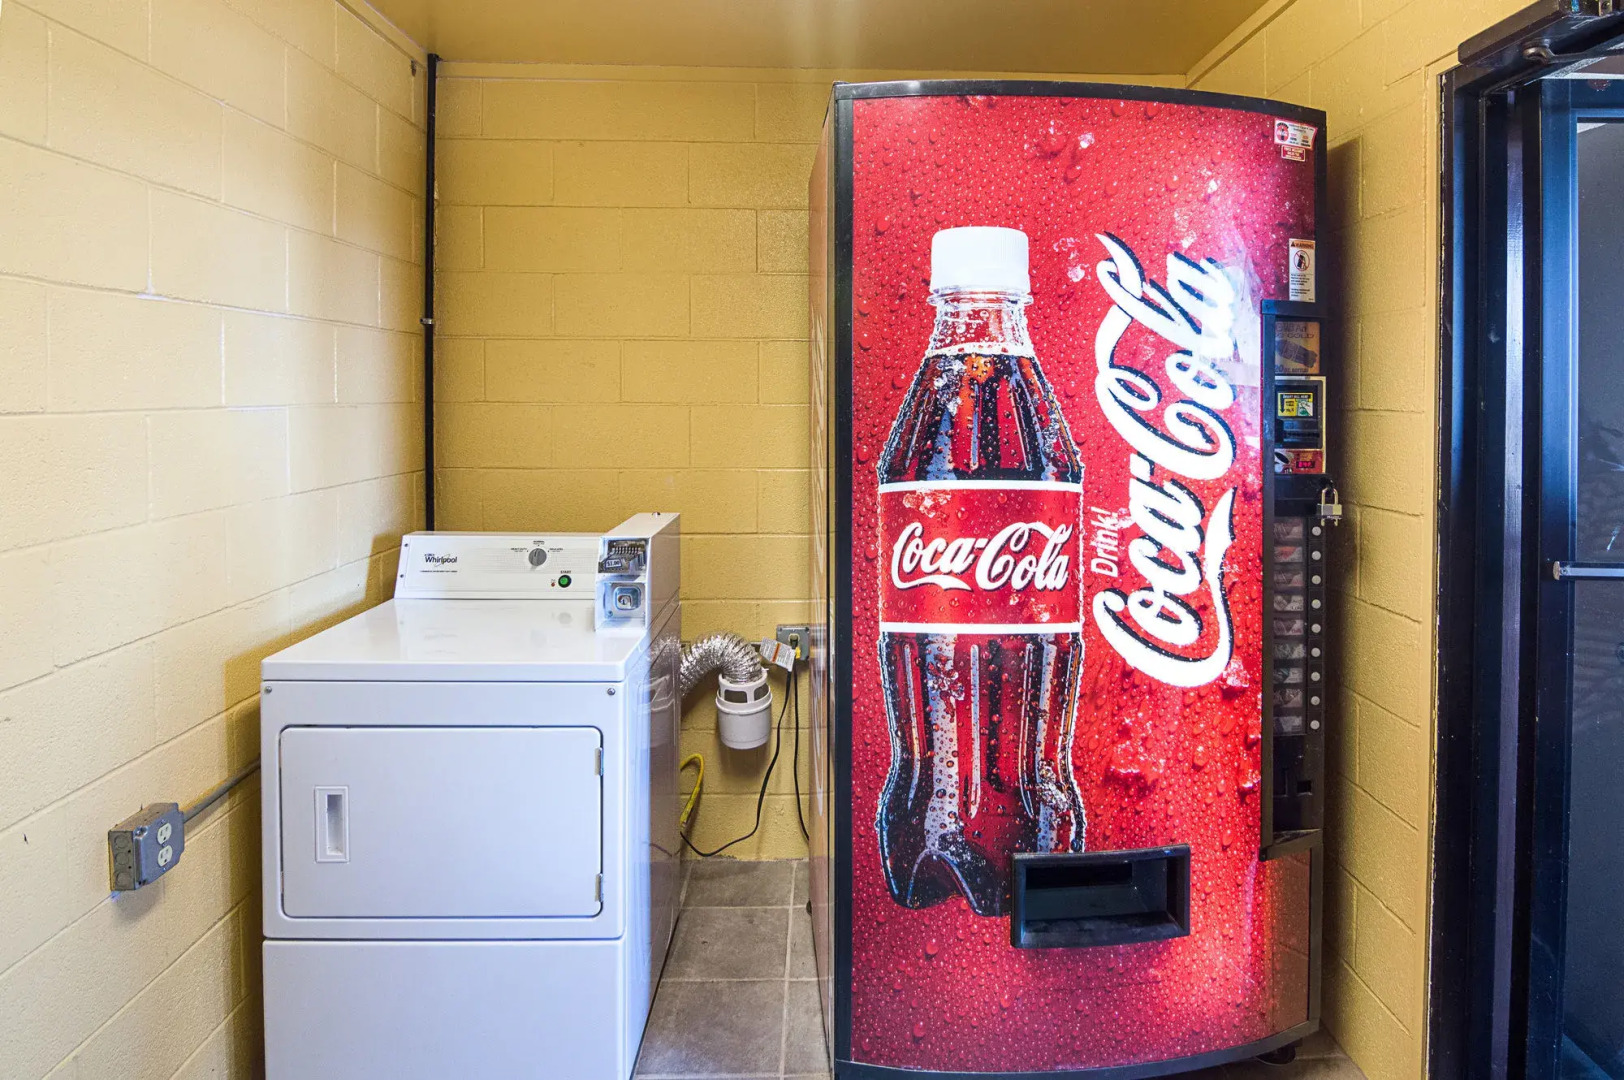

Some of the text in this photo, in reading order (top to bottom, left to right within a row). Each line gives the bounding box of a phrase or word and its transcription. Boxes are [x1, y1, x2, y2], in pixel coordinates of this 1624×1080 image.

[1092, 231, 1237, 688] Coca-Cola
[425, 556, 458, 565] Whirlpool
[891, 521, 1074, 592] Coca-Cola
[1091, 507, 1119, 577] Drink!
